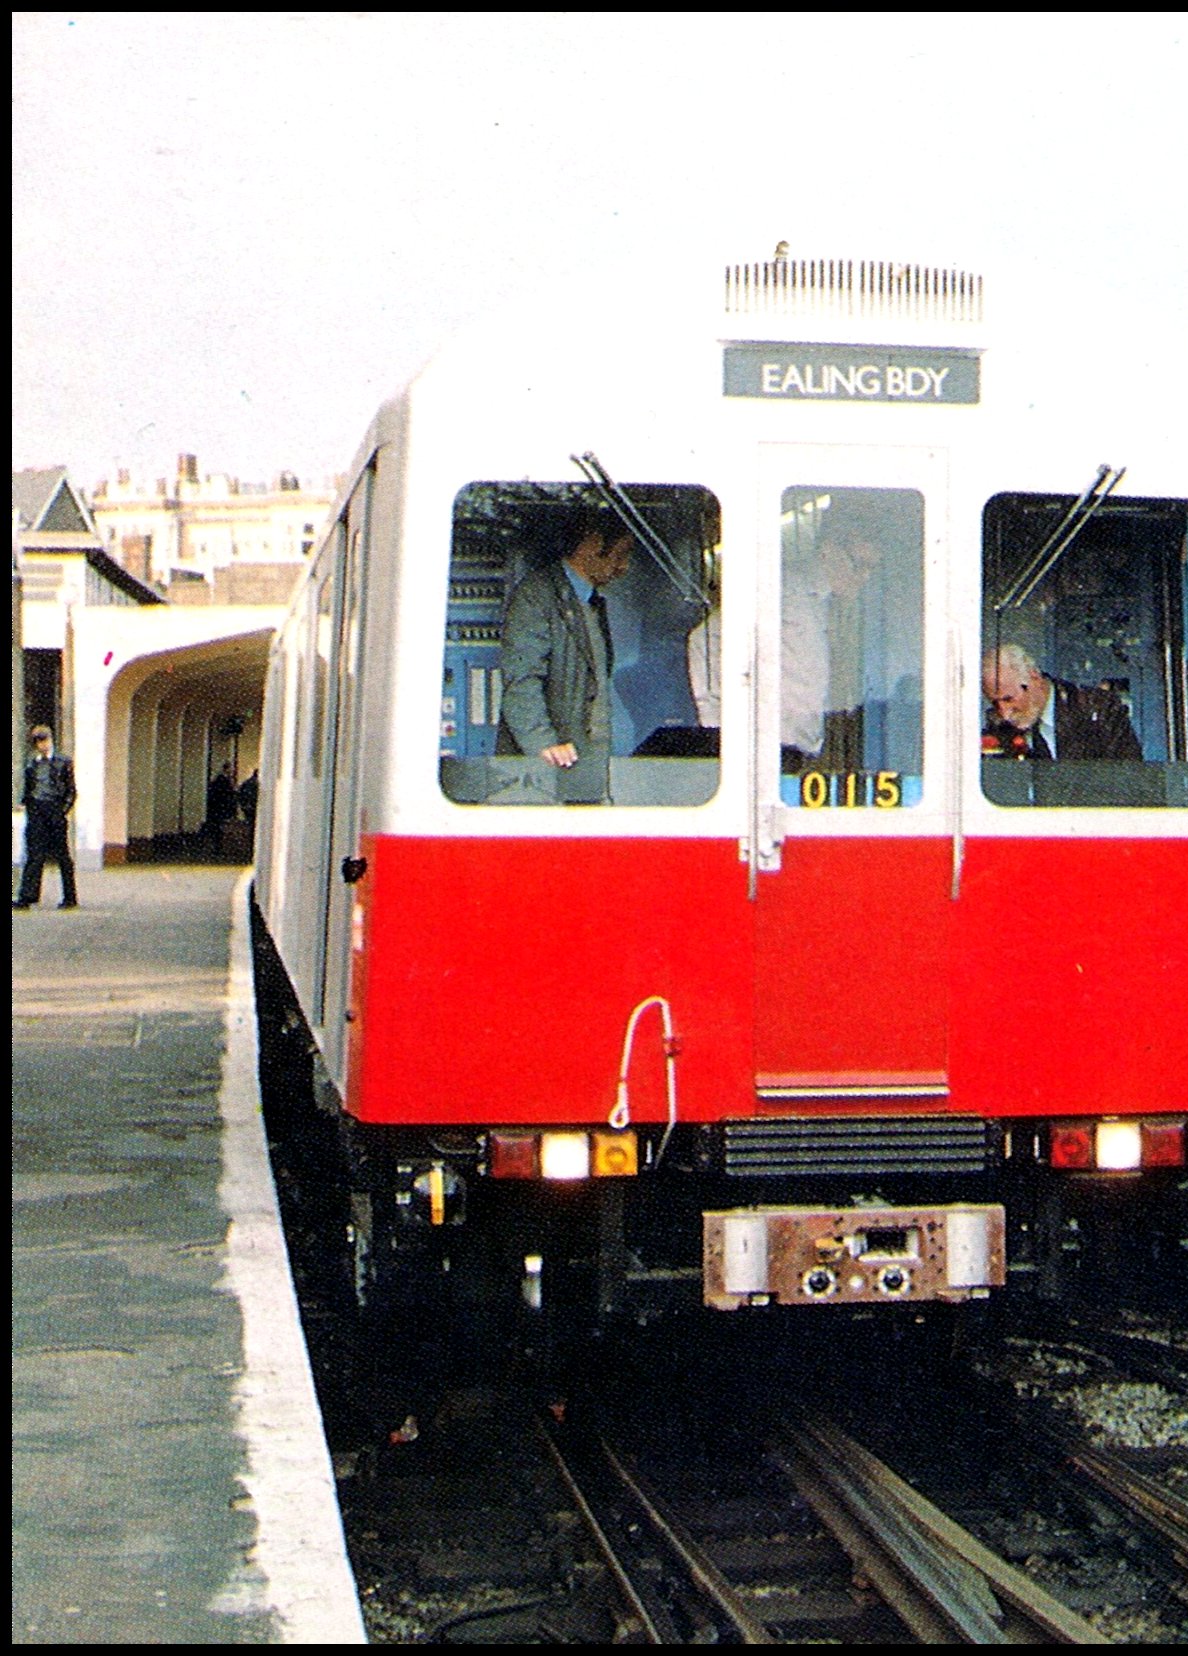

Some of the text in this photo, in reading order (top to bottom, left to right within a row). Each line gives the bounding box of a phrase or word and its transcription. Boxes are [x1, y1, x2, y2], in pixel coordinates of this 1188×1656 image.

[761, 364, 949, 397] EALING BDY
[802, 772, 899, 808] 015
